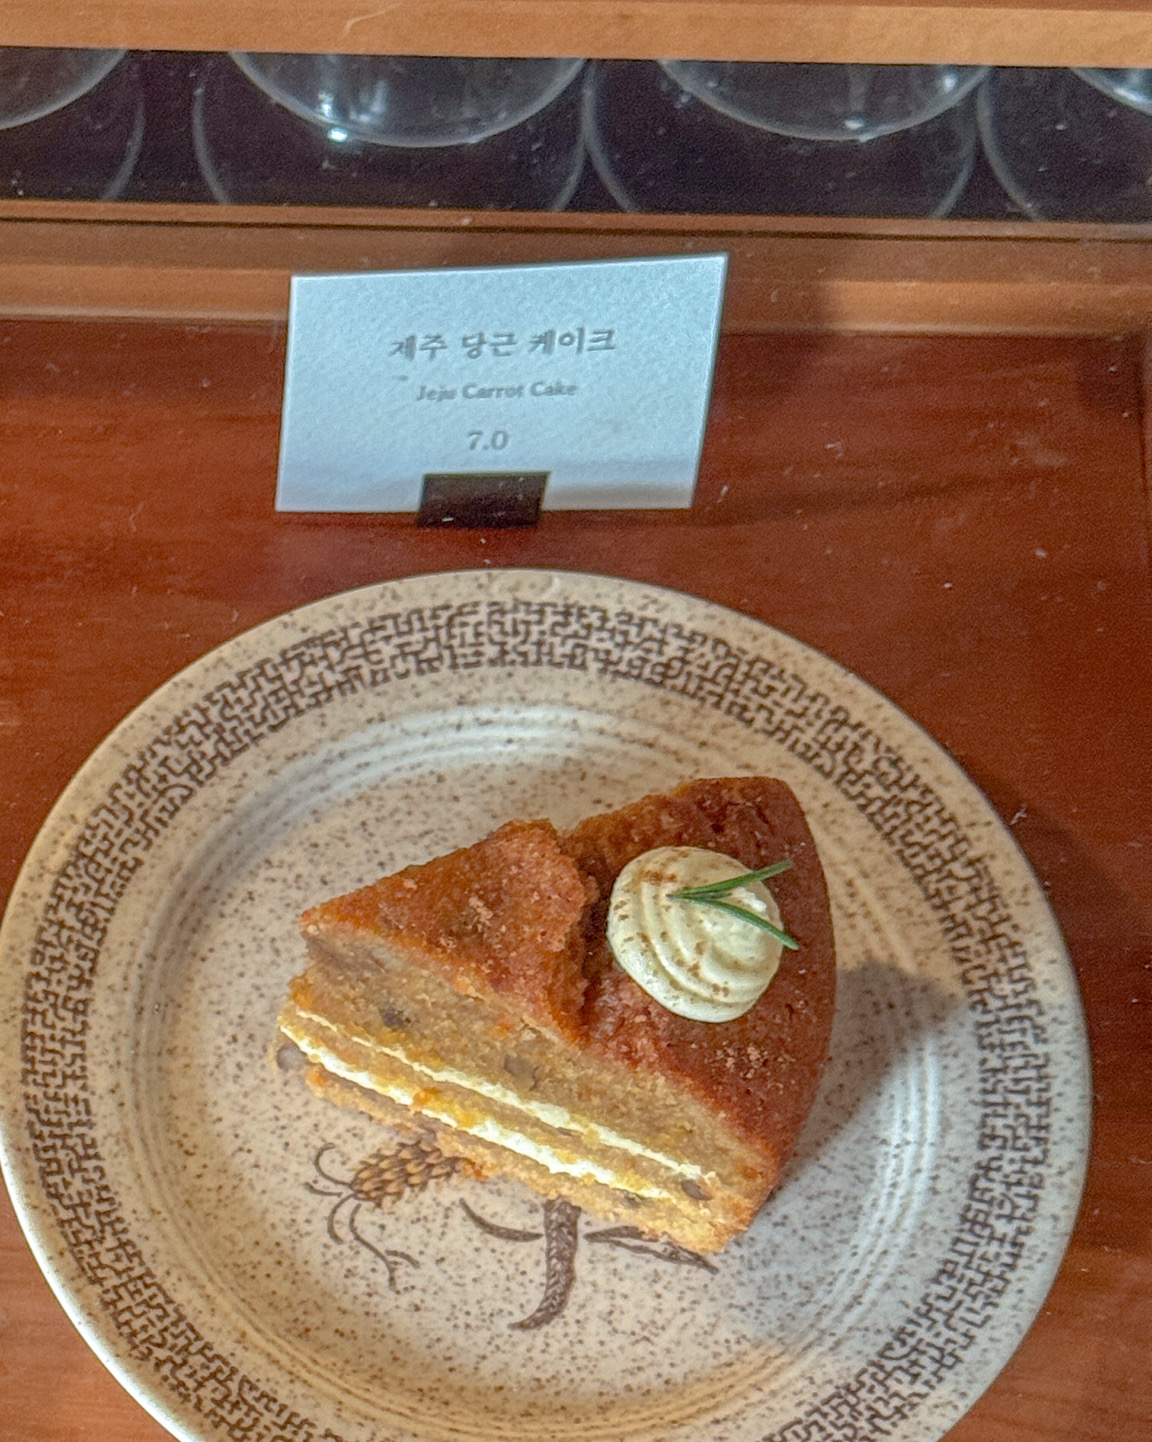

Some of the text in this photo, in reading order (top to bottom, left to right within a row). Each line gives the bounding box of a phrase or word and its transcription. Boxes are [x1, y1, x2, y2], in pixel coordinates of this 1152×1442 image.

[388, 327, 616, 361] 제주 당근 케이크
[416, 379, 577, 402] Jeju Carrot Cake
[467, 429, 510, 450] 7.0
